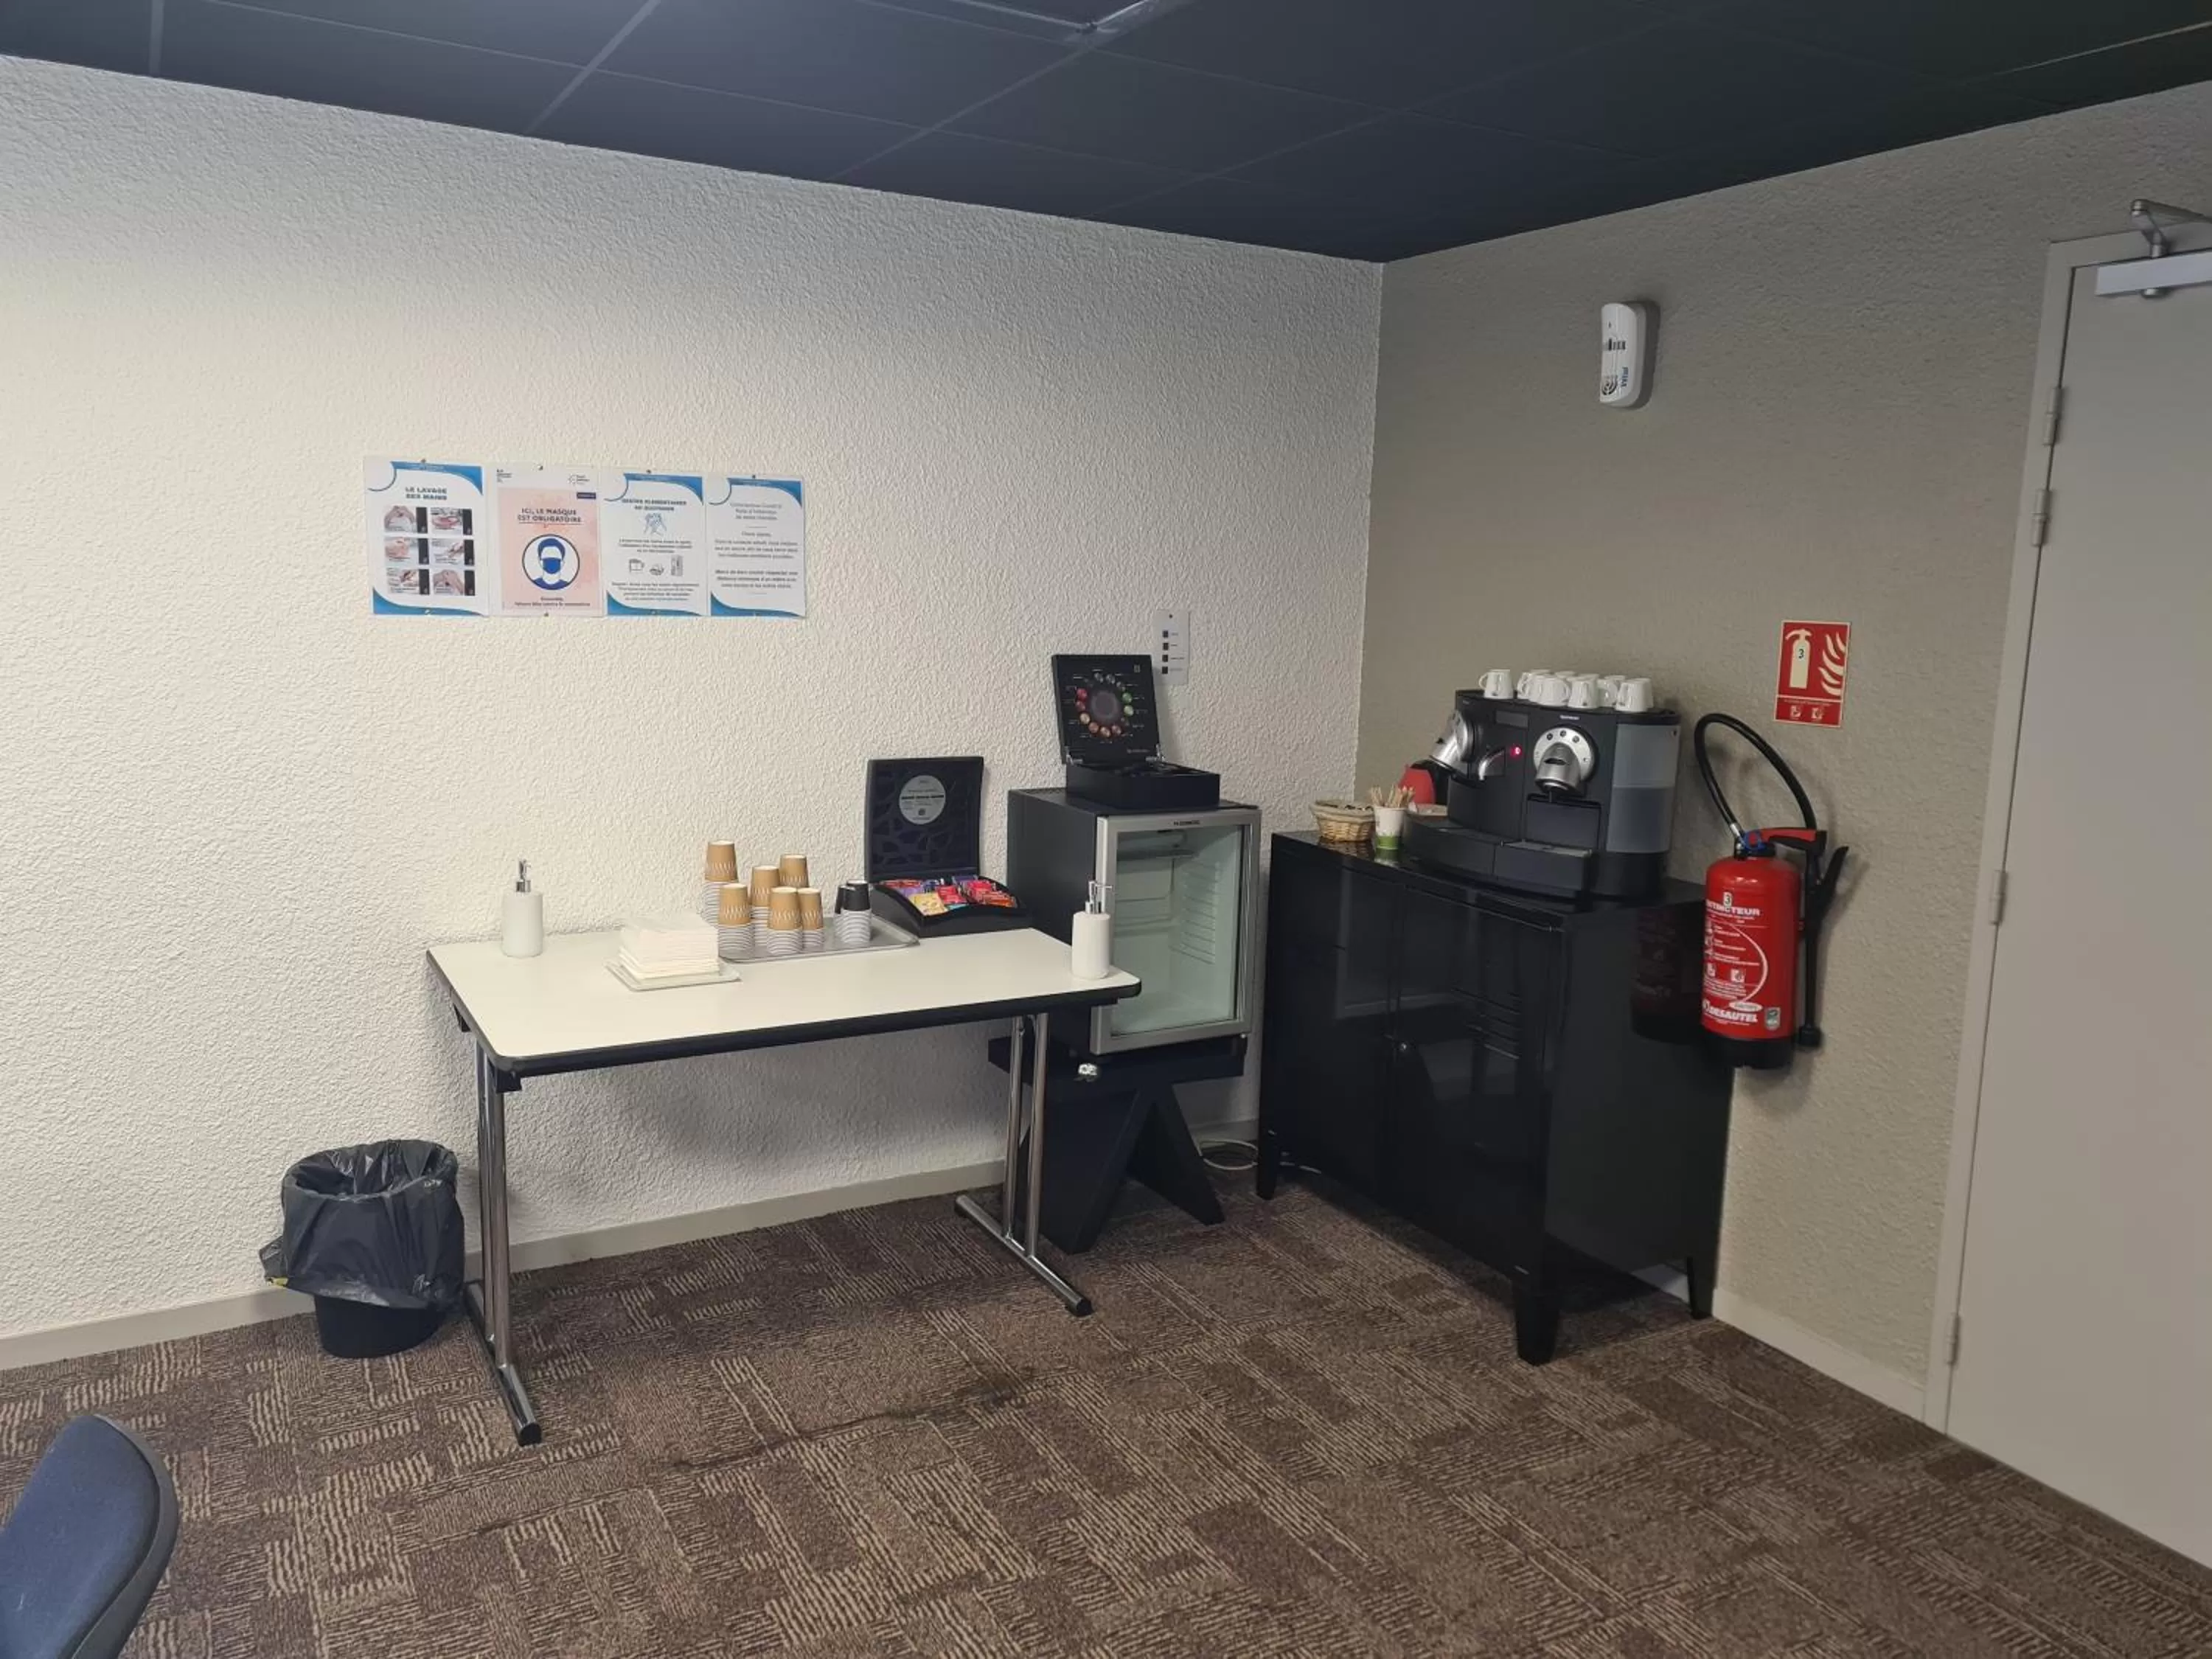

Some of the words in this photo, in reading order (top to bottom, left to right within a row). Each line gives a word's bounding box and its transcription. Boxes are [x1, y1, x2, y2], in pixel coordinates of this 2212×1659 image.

[546, 507, 577, 515] MASQUE
[532, 515, 582, 523] OBLIGATOIRE
[1798, 648, 1805, 660] 3
